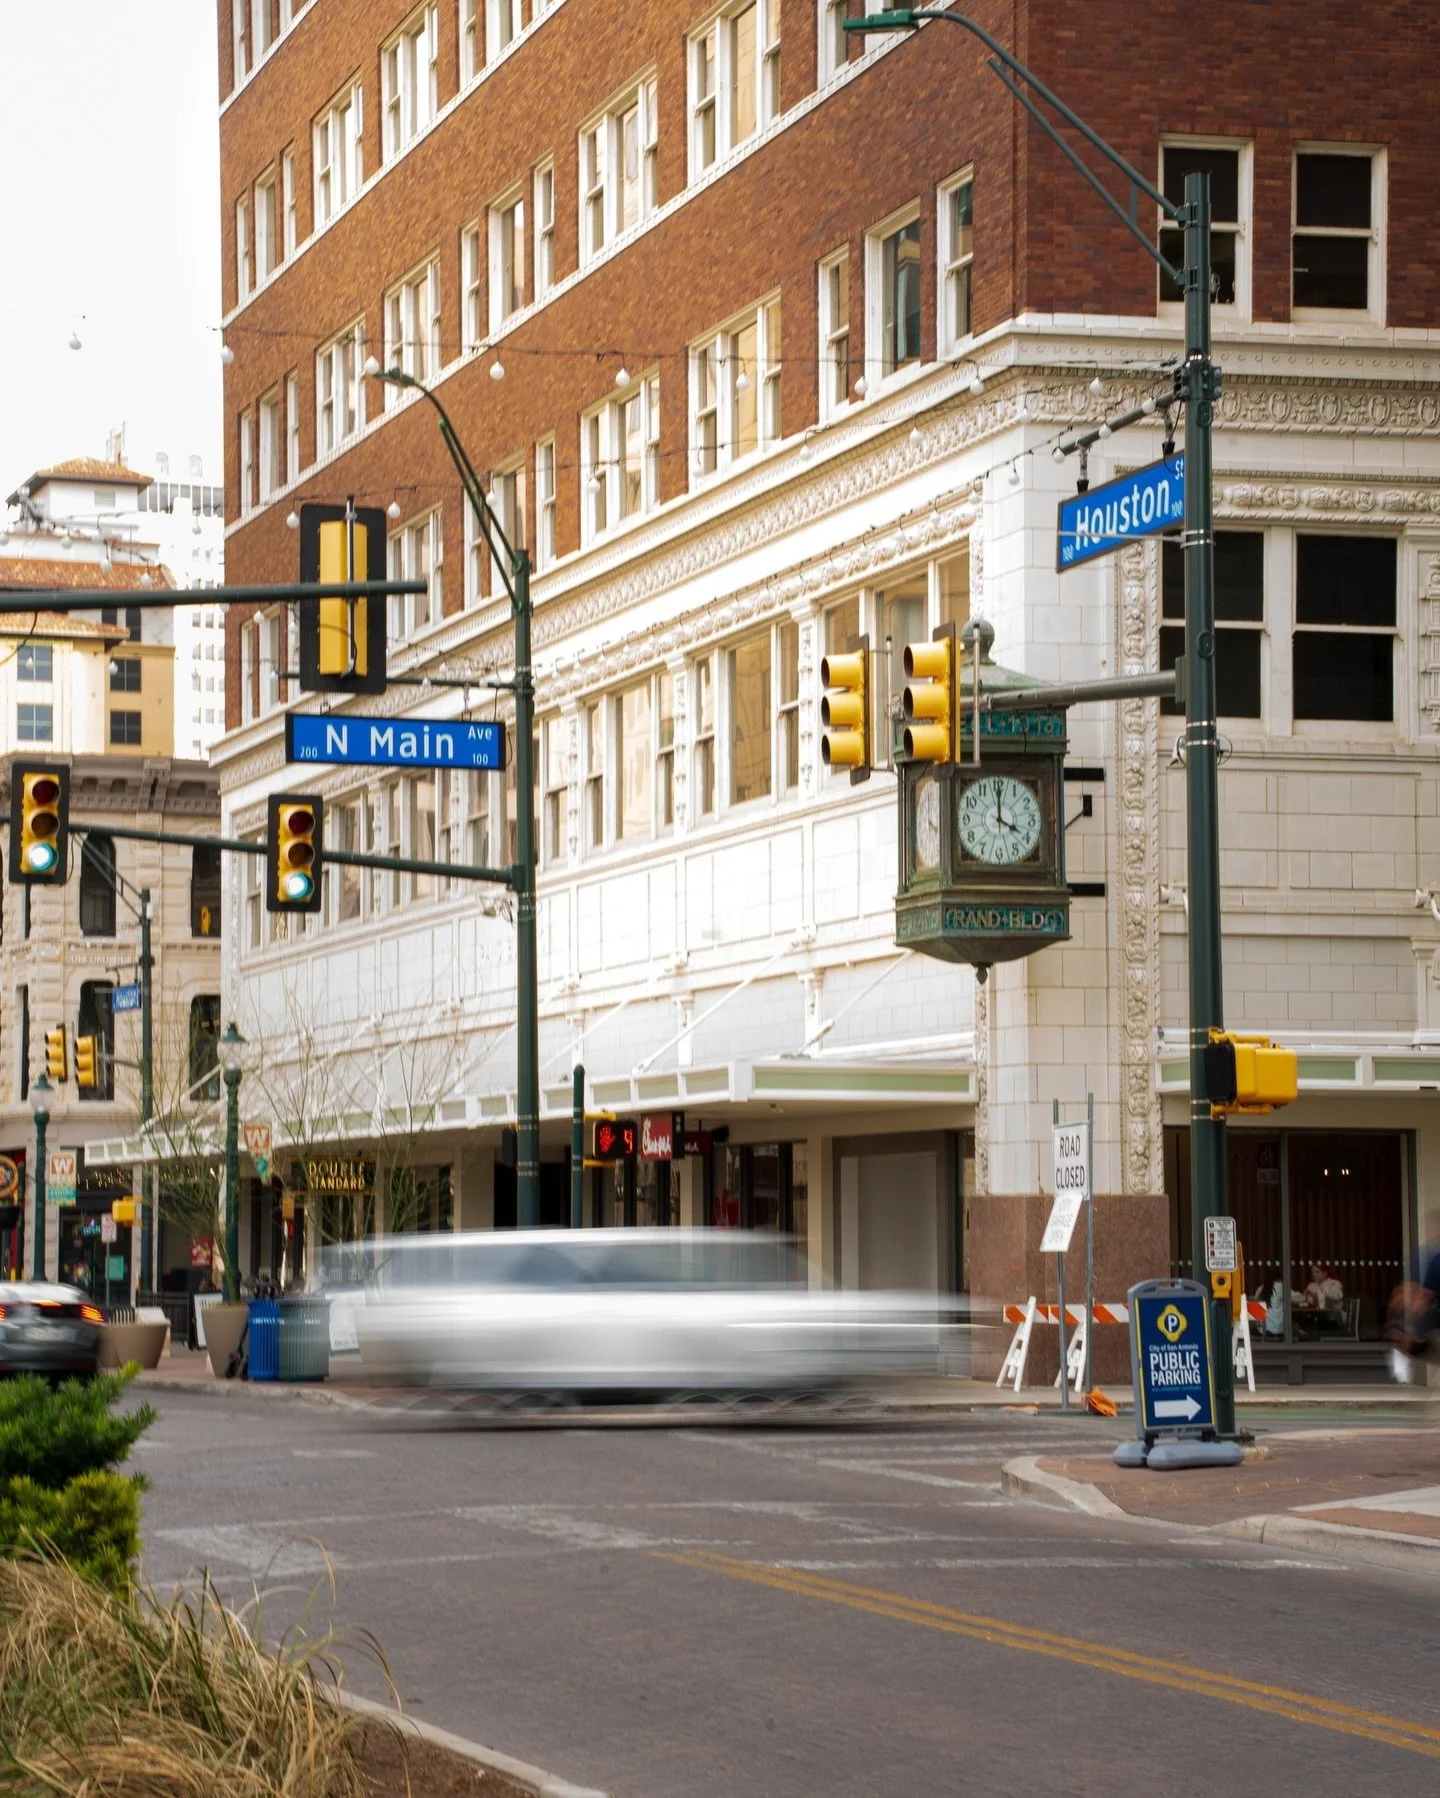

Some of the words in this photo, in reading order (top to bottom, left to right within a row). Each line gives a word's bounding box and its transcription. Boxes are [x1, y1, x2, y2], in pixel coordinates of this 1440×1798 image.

[1075, 479, 1170, 551] Houston
[468, 726, 493, 741] Ave
[326, 724, 348, 755] N
[370, 725, 454, 760] Main
[300, 746, 318, 759] 200
[472, 753, 489, 765] 100
[979, 783, 987, 797] 11
[1012, 783, 1017, 798] 1
[966, 795, 977, 809] 10
[1023, 796, 1030, 810] 2
[962, 813, 970, 826] 9
[1028, 814, 1036, 827] 3
[967, 830, 975, 843] 8
[1022, 831, 1031, 844] 4
[980, 842, 987, 855] 7
[995, 847, 1003, 860] 6
[1012, 842, 1019, 856] 5
[1060, 1135, 1081, 1158] ROAD
[309, 1160, 366, 1177] DOUBLE
[1055, 1166, 1085, 1189] CLOSED
[1167, 1314, 1179, 1333] P
[1178, 1343, 1199, 1351] Antonio
[1150, 1351, 1200, 1371] PUBLIC
[1150, 1369, 1201, 1387] PARKING
